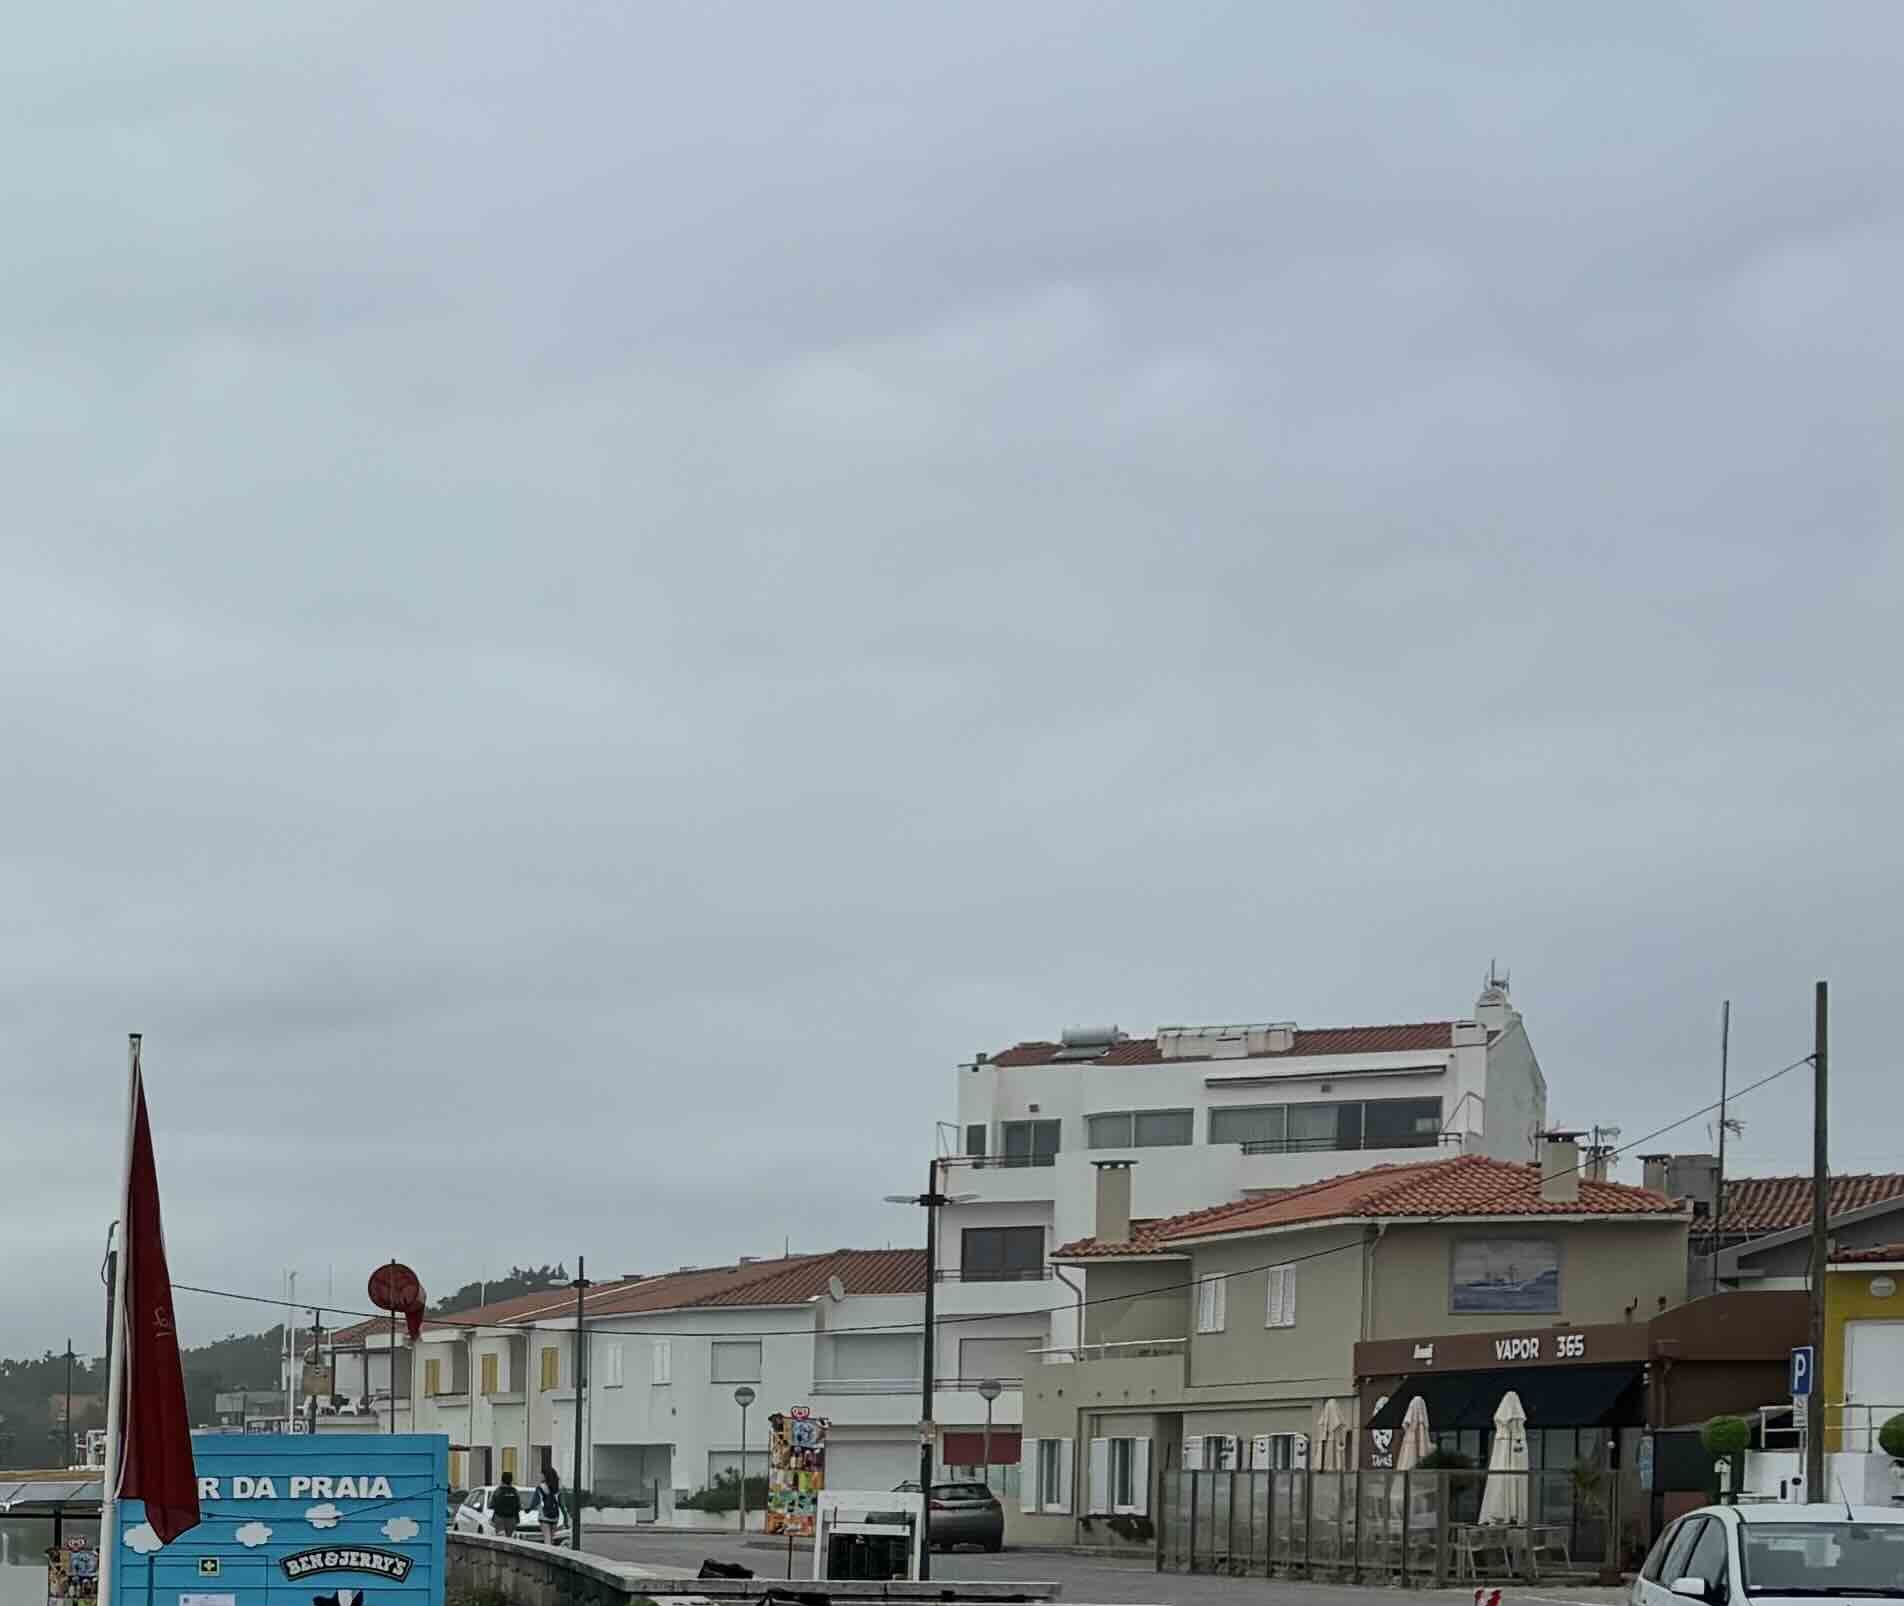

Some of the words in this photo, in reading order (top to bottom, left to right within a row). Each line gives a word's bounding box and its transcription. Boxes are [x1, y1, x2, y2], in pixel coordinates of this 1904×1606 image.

[1495, 1338, 1540, 1361] VAPOR
[1556, 1334, 1585, 1358] 365
[1794, 1353, 1807, 1391] P
[232, 1477, 279, 1499] DA
[290, 1476, 393, 1499] PRAIA
